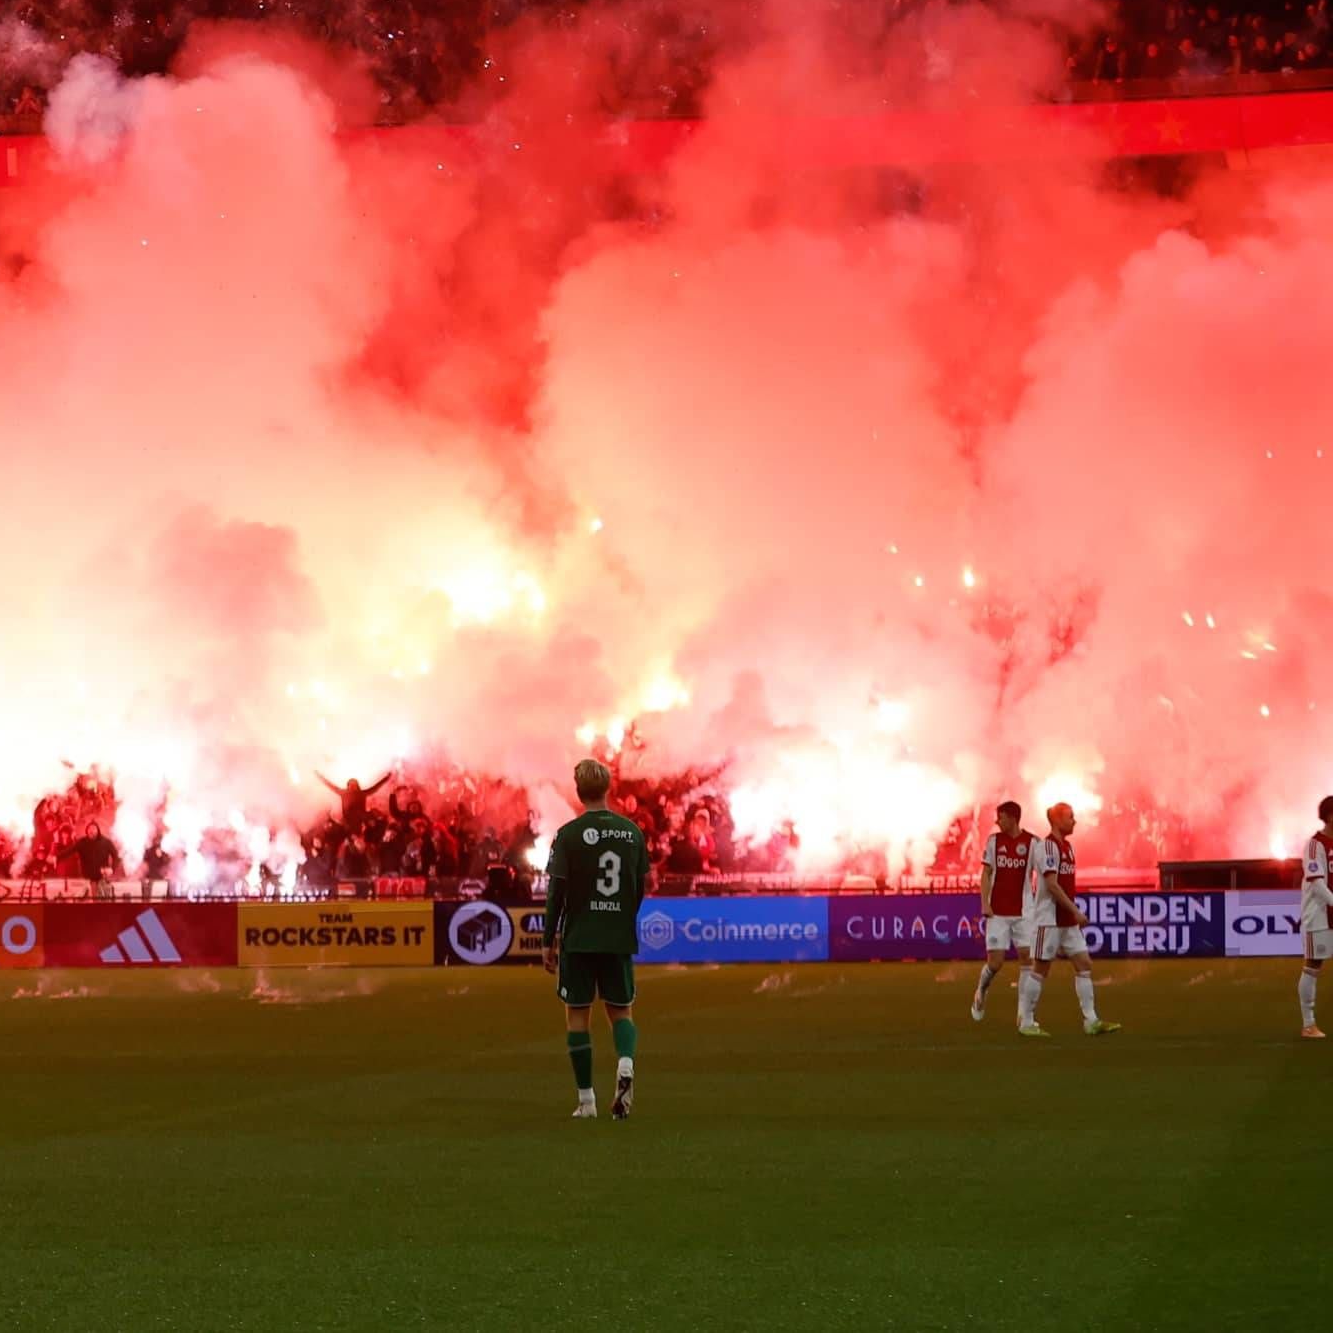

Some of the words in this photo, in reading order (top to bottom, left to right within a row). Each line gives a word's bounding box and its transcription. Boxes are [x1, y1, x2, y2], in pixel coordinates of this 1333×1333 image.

[597, 850, 622, 897] 3
[319, 913, 353, 924] TEAM
[684, 917, 819, 941] Coinmerce
[245, 927, 397, 947] ROCKSTARS
[404, 927, 425, 946] IT
[1082, 925, 1191, 955] OTERIJ
